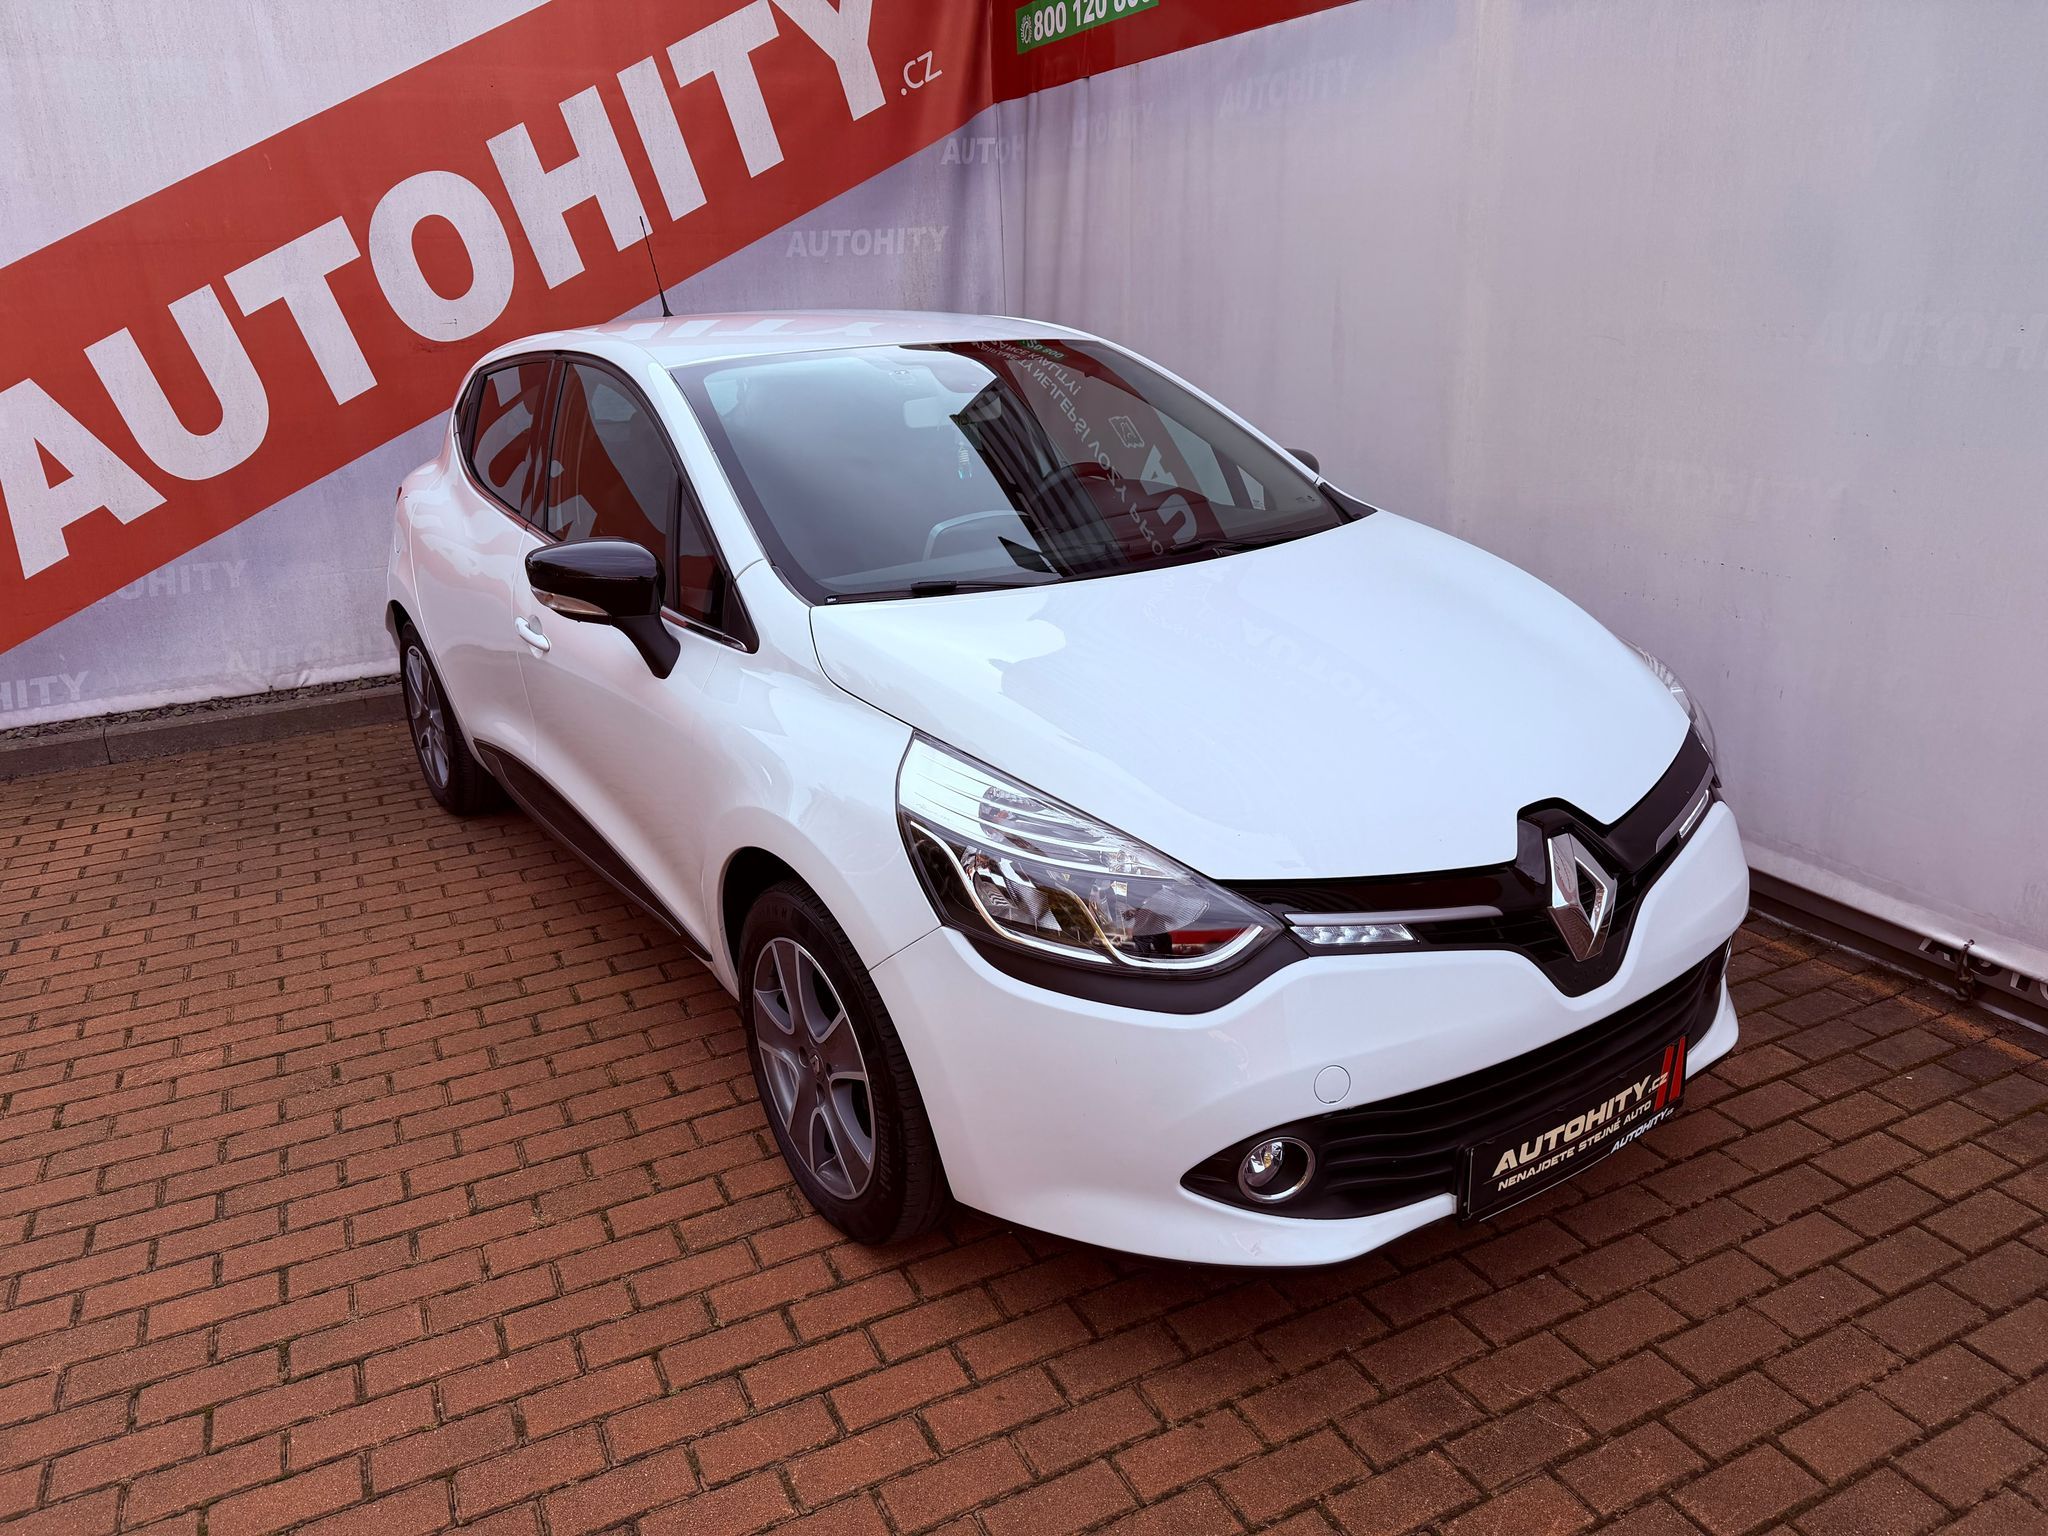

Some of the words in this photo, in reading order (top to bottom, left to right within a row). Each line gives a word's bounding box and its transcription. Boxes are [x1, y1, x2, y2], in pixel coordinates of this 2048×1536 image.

[1034, 2, 1067, 41] 800
[1072, 0, 1107, 27] 120
[785, 226, 949, 258] AUTOHITY
[1497, 1146, 1575, 1192] NENAJDETE
[1578, 1117, 1621, 1152] STEJNÉ
[1623, 1099, 1652, 1126] AUTO
